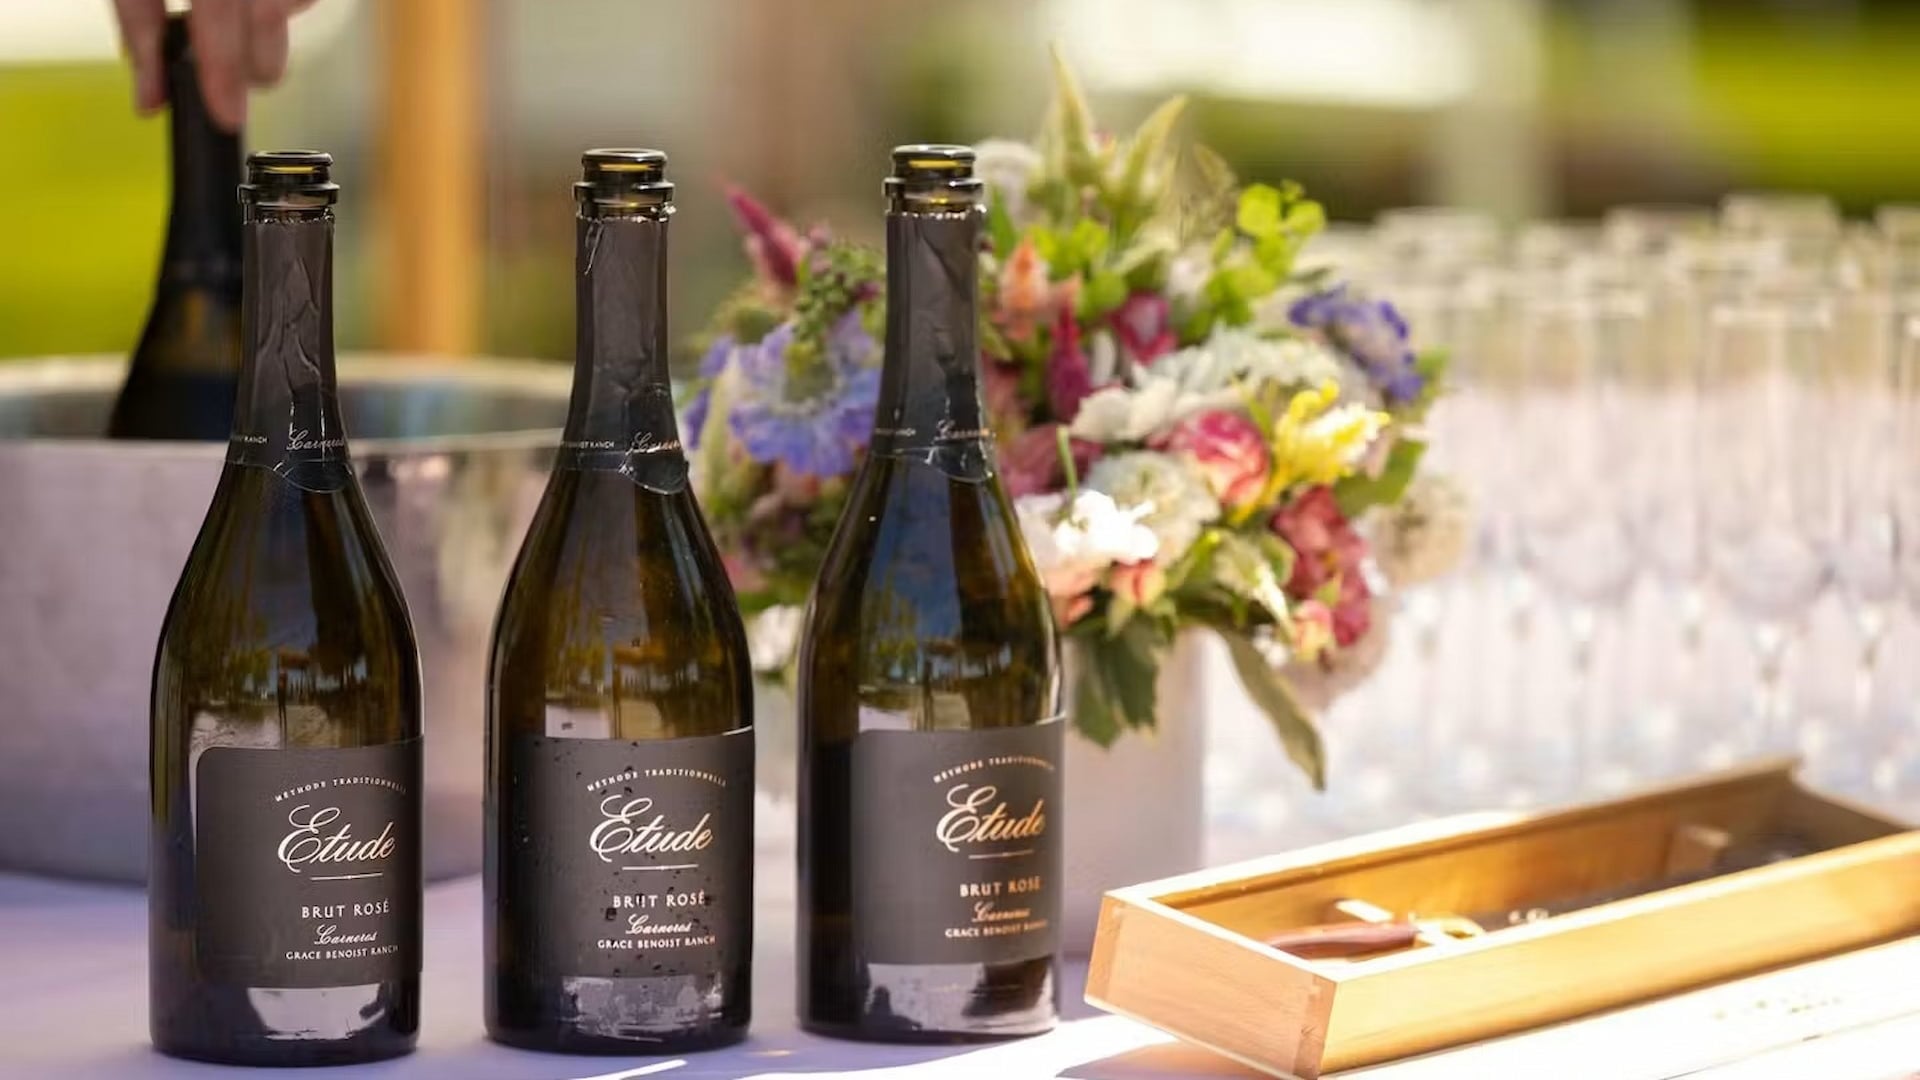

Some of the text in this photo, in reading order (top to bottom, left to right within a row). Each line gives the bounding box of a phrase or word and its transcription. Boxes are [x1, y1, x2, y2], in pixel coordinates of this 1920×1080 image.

[590, 794, 713, 863] Etude
[936, 784, 1046, 852] Etude
[277, 804, 396, 873] Etude
[613, 889, 705, 908] BRUT ROSÉ
[960, 882, 1002, 898] BRUT
[301, 898, 389, 919] BRUT ROSÉ
[314, 924, 378, 945] Carneros
[597, 935, 716, 949] GRACE BENOIST RANCH
[286, 951, 321, 960] GRACE
[326, 948, 367, 959] BENOIST
